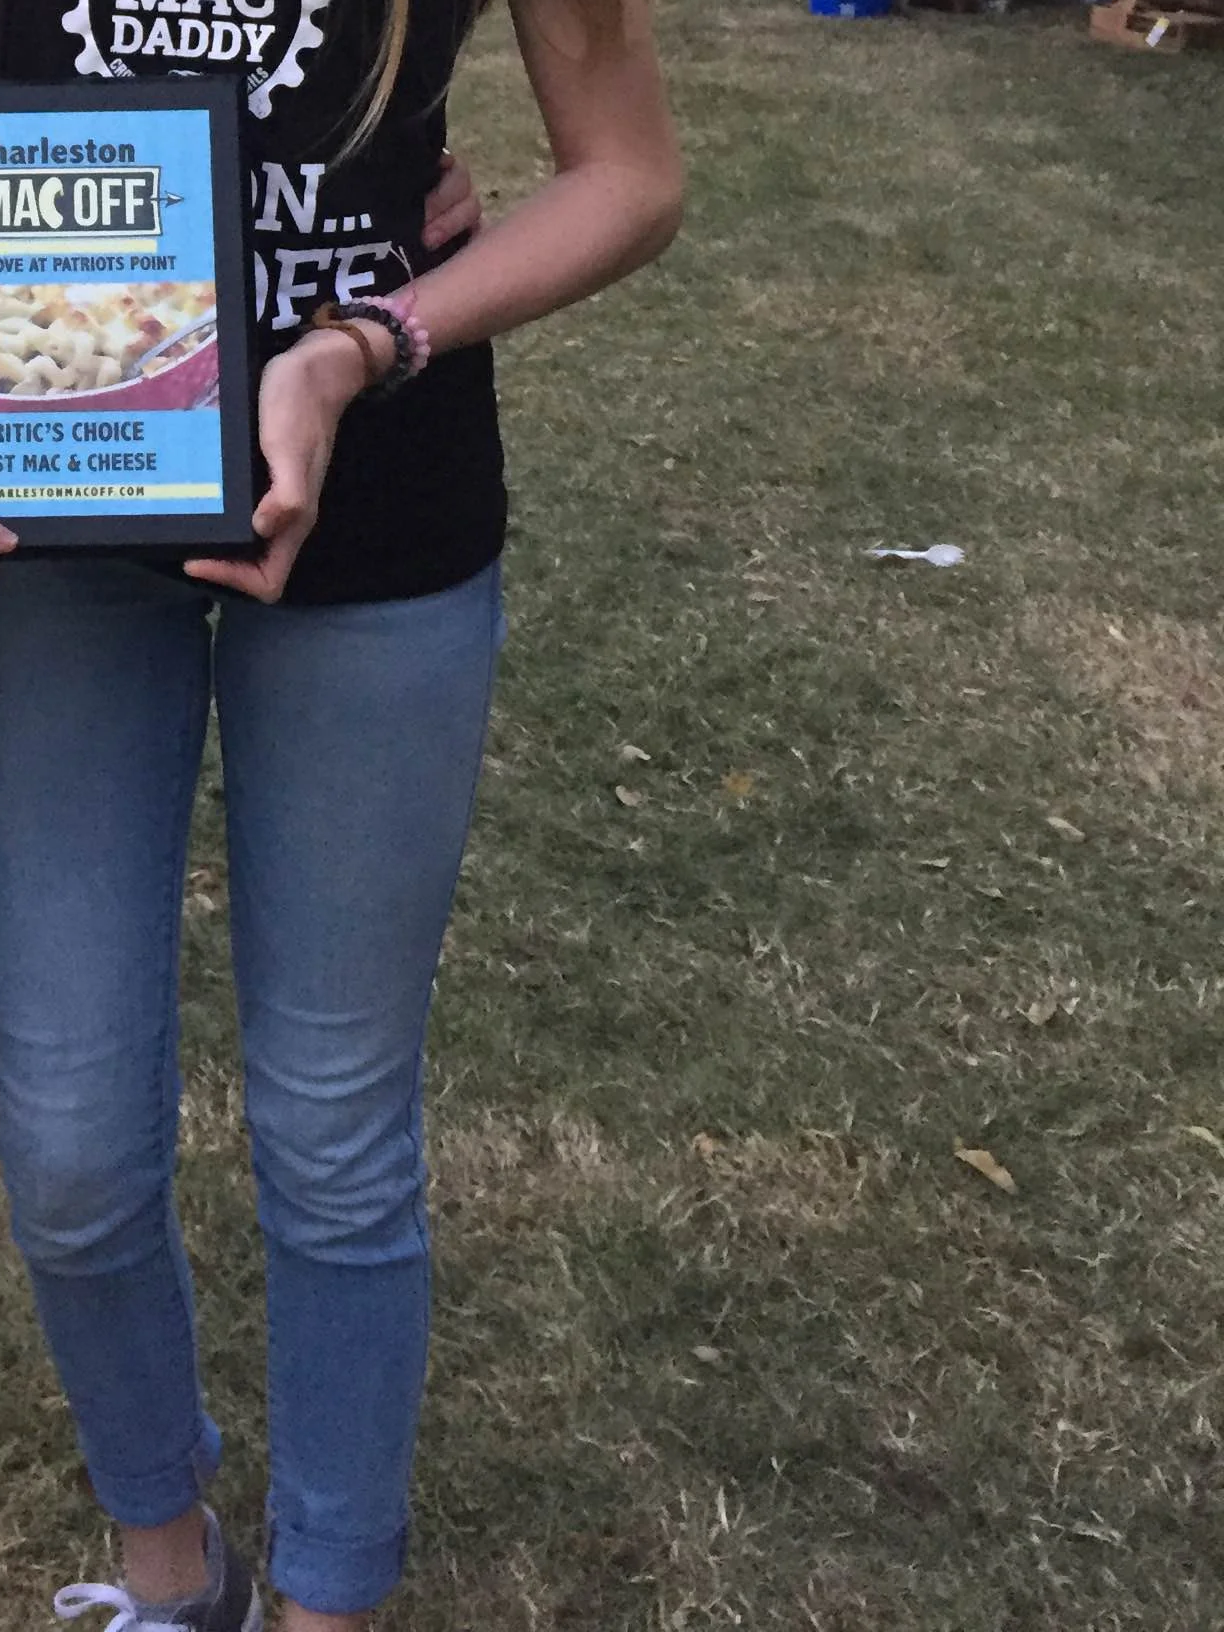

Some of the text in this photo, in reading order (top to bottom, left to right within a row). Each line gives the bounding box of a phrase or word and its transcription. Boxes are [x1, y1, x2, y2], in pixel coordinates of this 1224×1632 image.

[110, 15, 276, 62] DADDY
[73, 178, 147, 226] OFF
[251, 162, 372, 233] N...
[29, 257, 48, 272] AT
[52, 256, 126, 272] PATRIOTS
[130, 255, 177, 271] POINT
[71, 421, 145, 442] CHOICE
[22, 453, 61, 472] MAC
[67, 452, 81, 472] &
[87, 452, 157, 472] CHEESE
